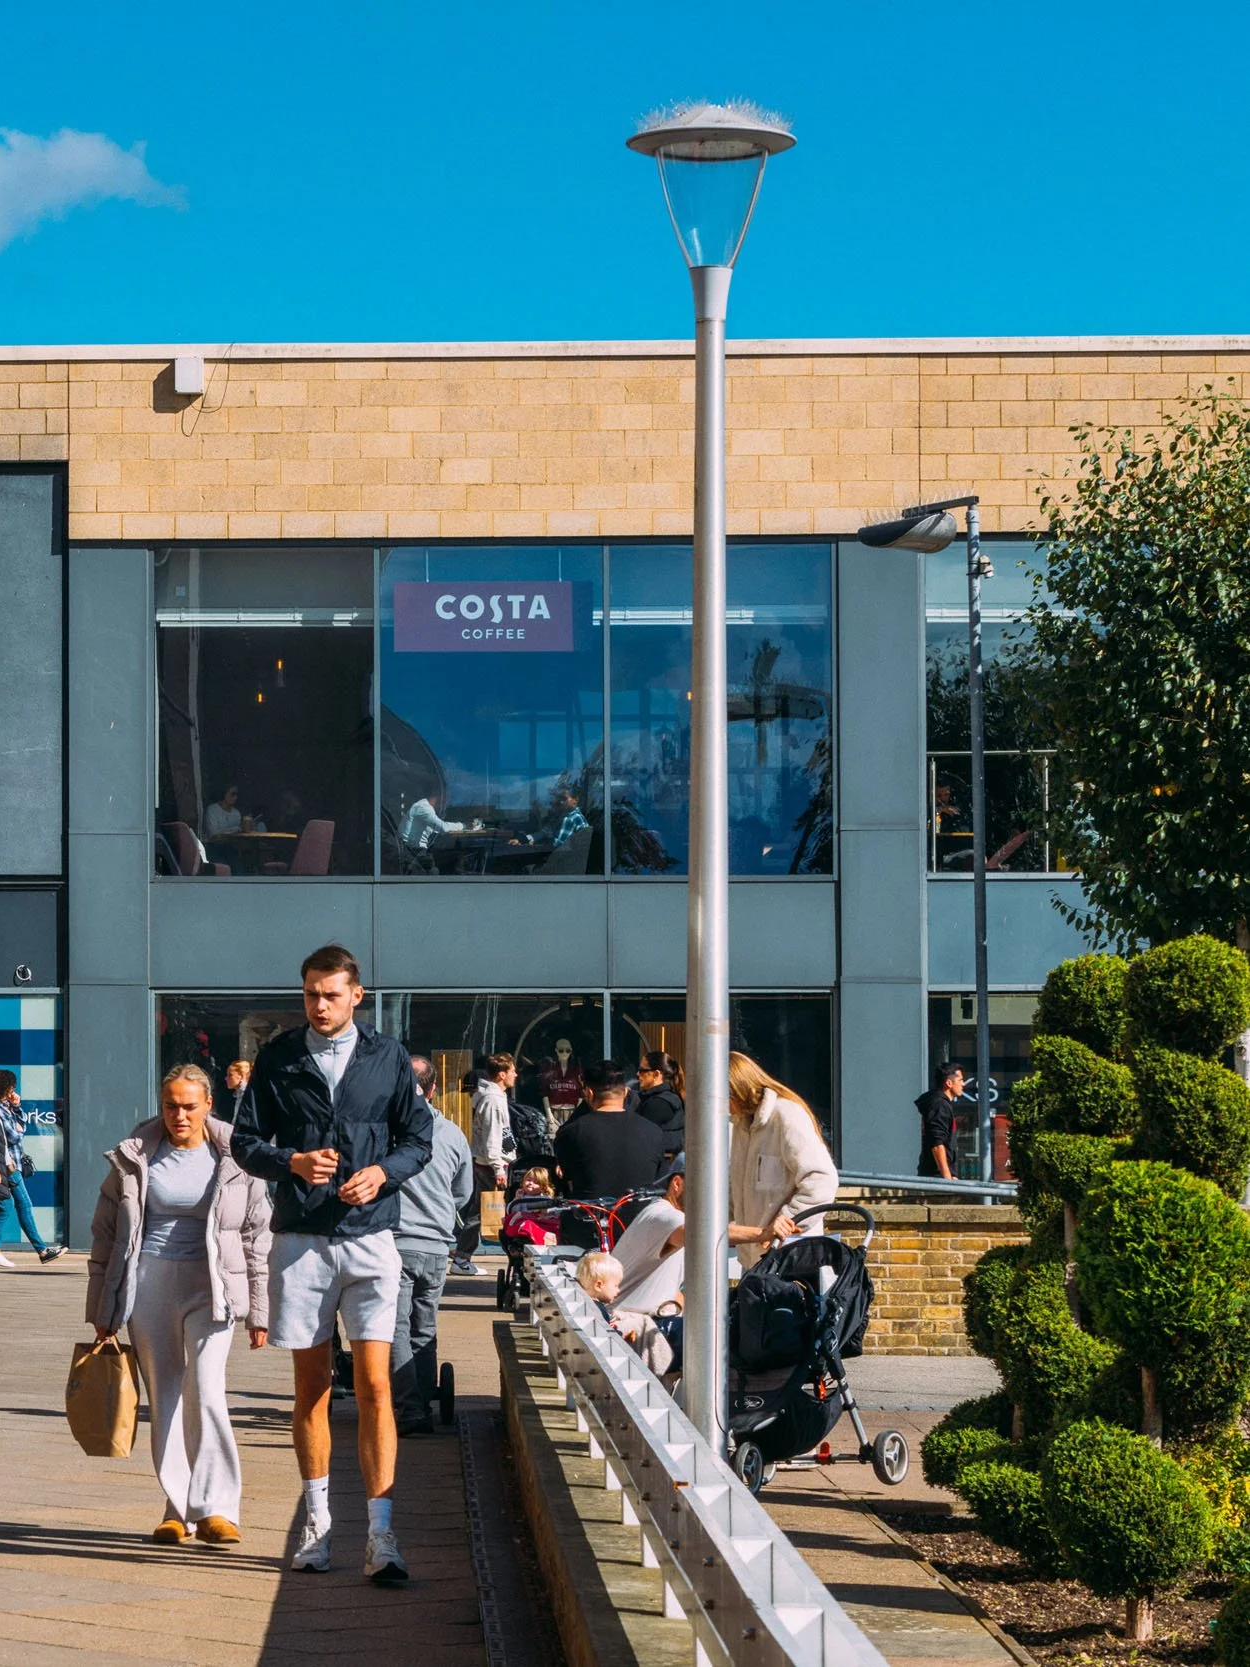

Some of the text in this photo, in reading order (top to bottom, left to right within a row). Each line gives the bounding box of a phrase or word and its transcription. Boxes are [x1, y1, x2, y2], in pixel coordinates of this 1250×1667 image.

[435, 594, 550, 623] COSTA
[461, 629, 525, 639] COFFEE
[23, 1107, 57, 1124] rks
